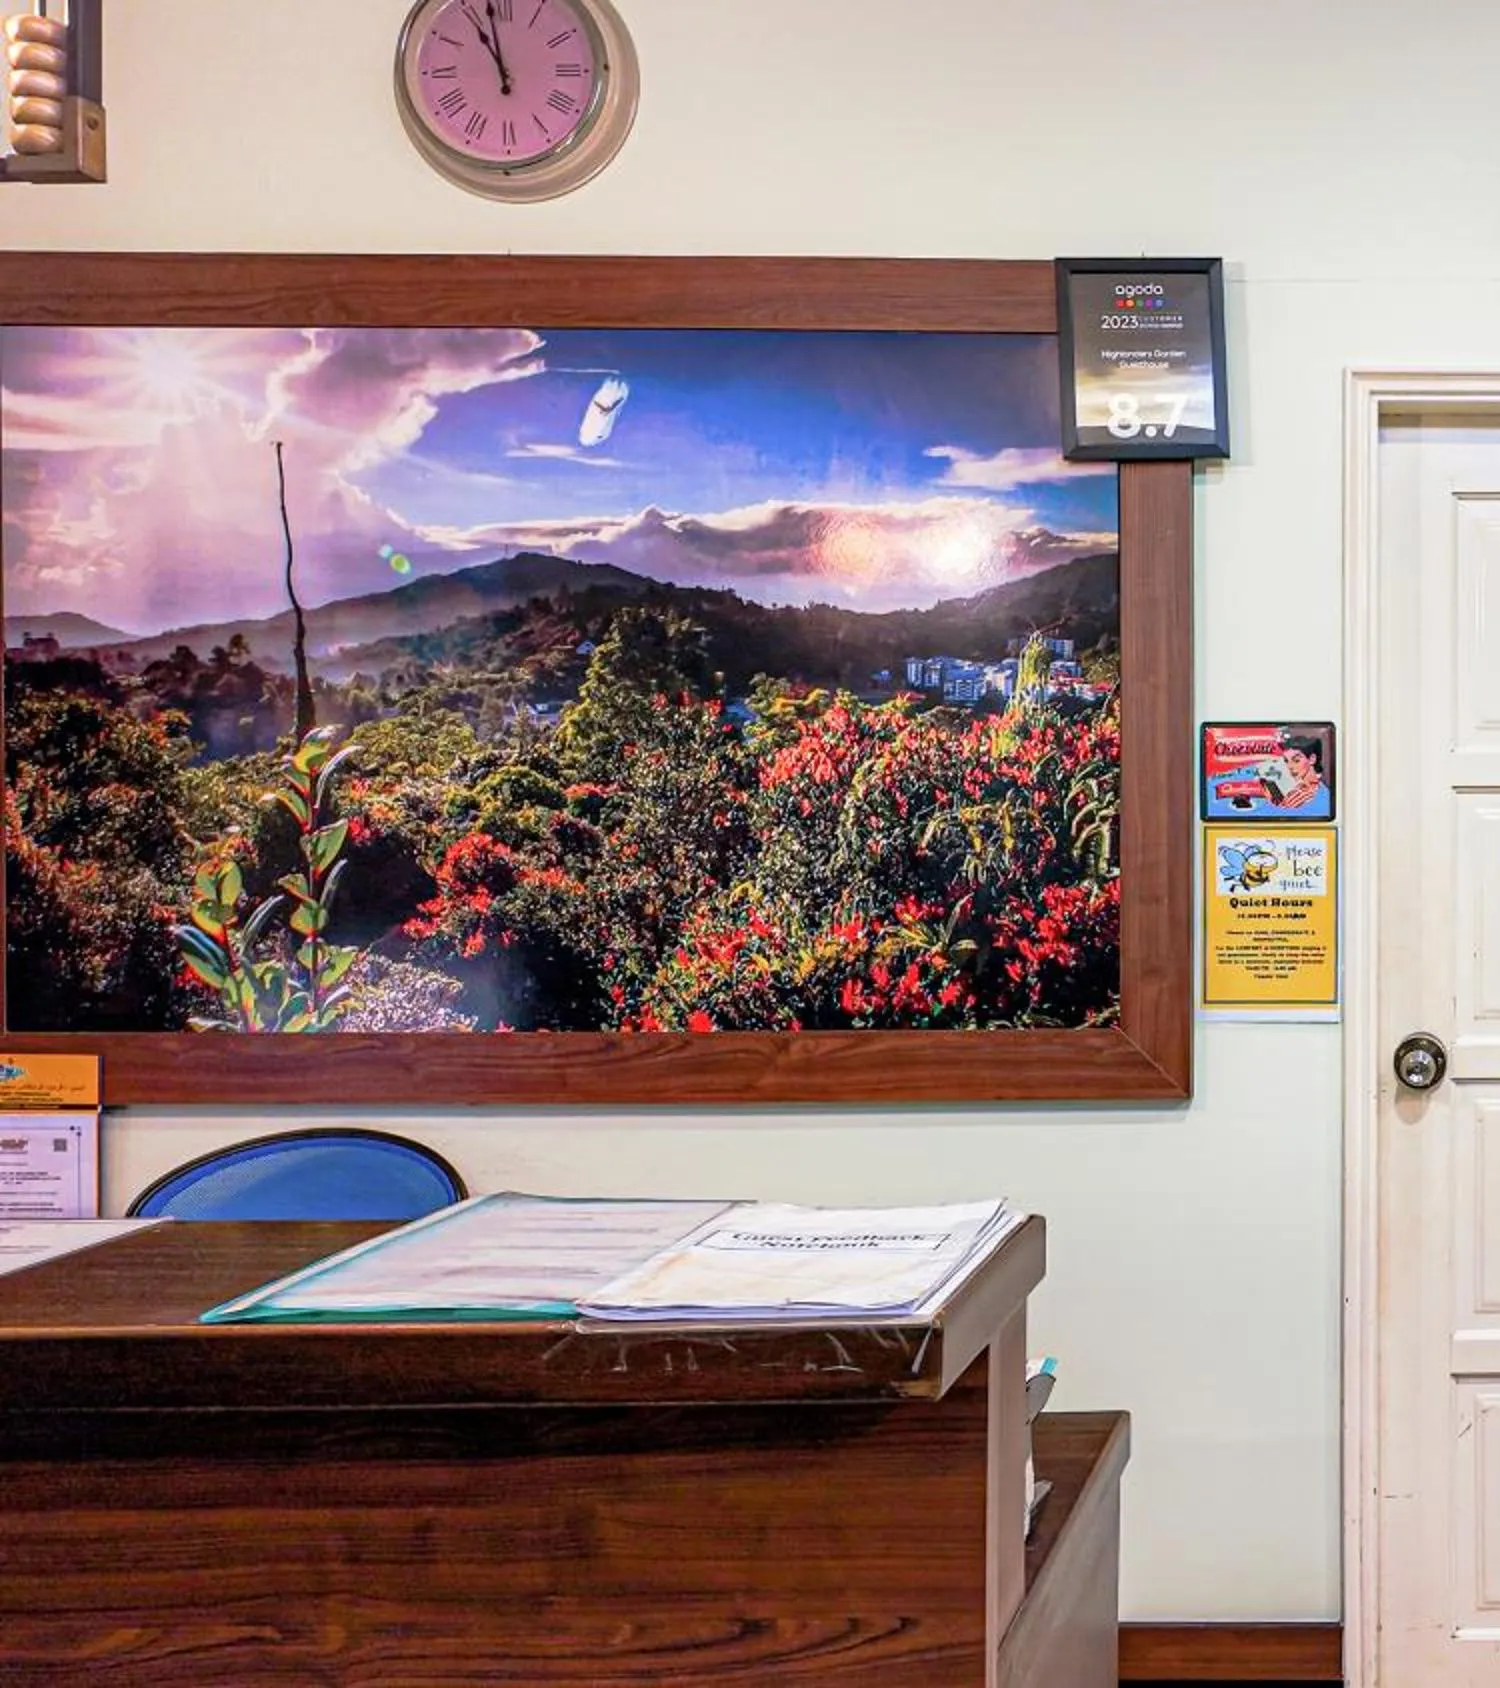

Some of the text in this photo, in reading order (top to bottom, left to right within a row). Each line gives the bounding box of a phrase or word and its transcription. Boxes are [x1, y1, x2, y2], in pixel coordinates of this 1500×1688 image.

[1115, 284, 1164, 298] agoda
[1101, 314, 1139, 329] 2023
[1107, 393, 1187, 439] 8.7
[1286, 845, 1322, 860] please
[1293, 859, 1322, 877] bee
[1229, 897, 1314, 909] Quiet Hours
